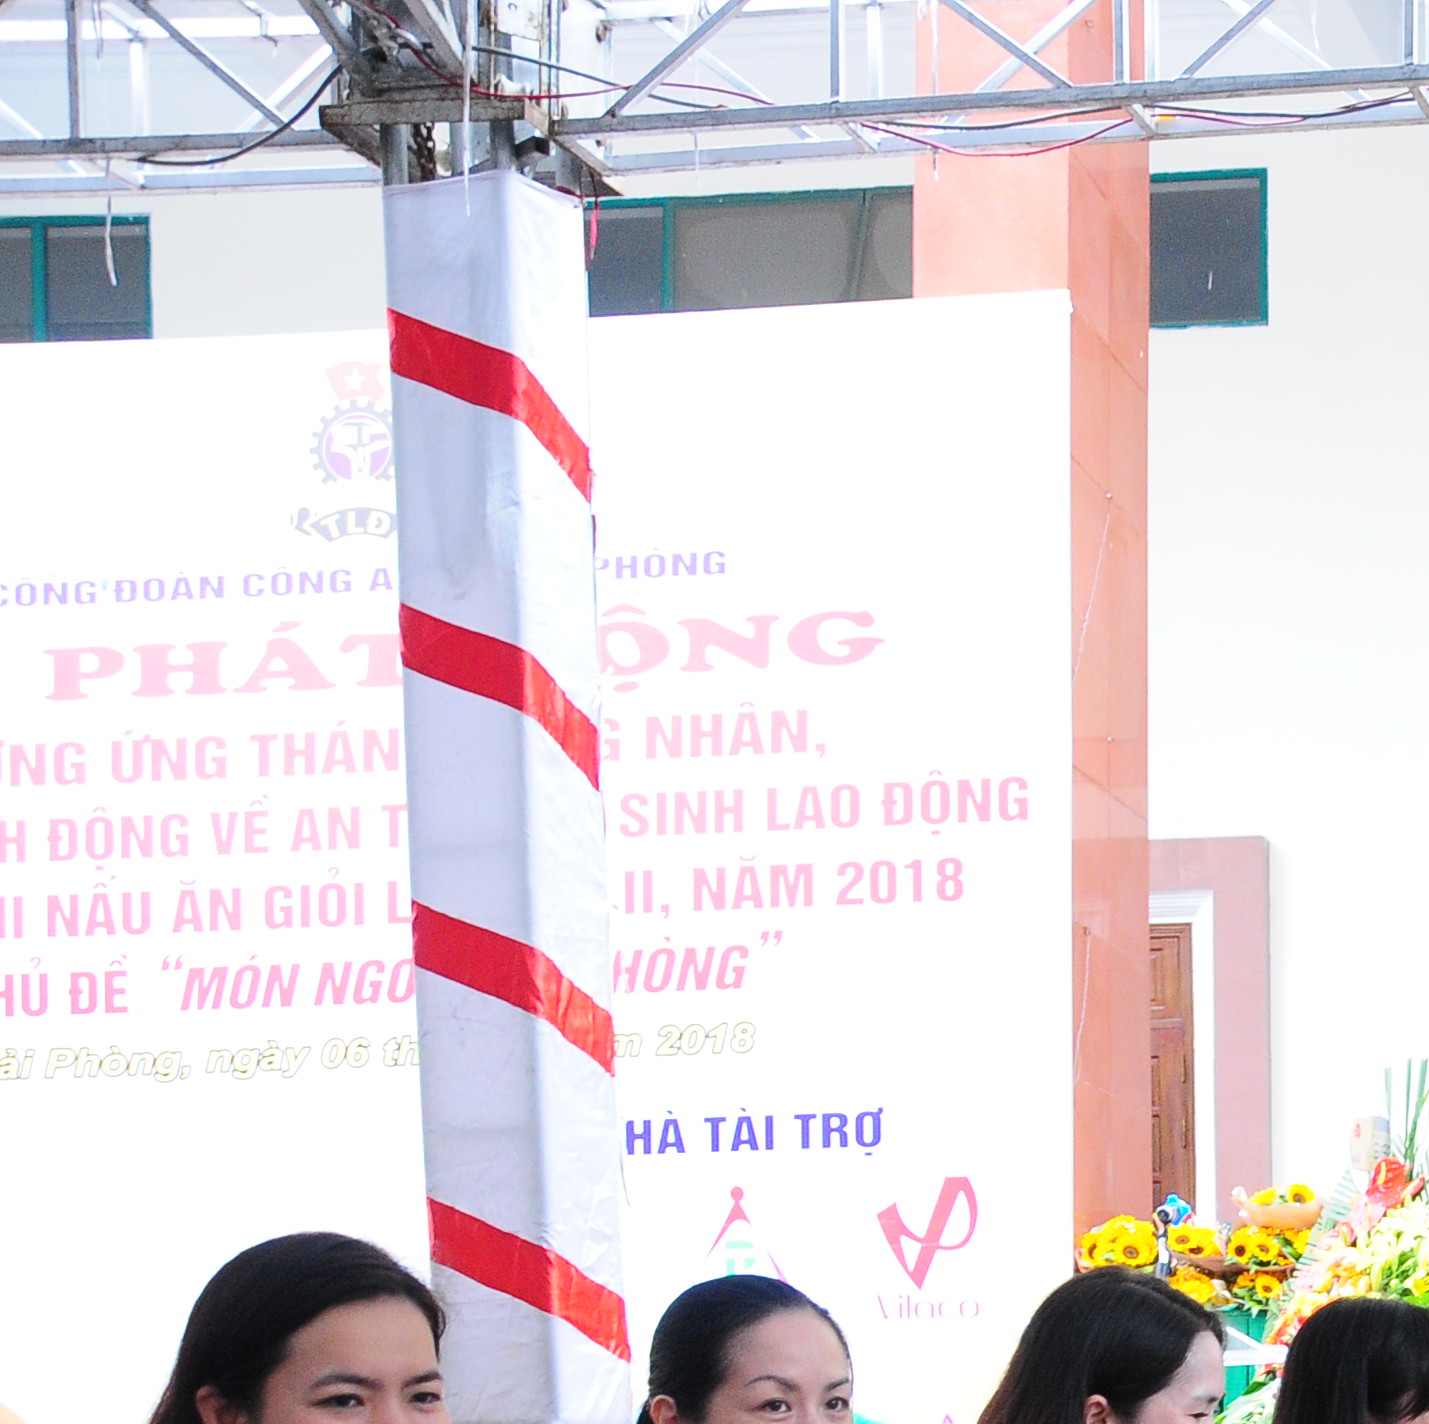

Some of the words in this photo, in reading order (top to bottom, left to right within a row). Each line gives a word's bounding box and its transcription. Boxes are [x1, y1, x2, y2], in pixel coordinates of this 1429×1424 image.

[113, 571, 225, 603] ĐOÀN
[243, 566, 353, 598] CÔNG
[43, 621, 402, 701] PHÁT
[0, 738, 87, 787] NG
[110, 730, 228, 784] ỨNG
[645, 702, 828, 760] NHÂN,
[48, 806, 190, 870] ĐỘNG
[210, 794, 270, 855] VỀ
[290, 805, 361, 852] AN
[619, 788, 744, 838] SINH
[766, 783, 861, 831] LAO
[882, 770, 1029, 836] ĐỘNG
[47, 876, 150, 937] NẤU
[172, 879, 242, 933] ĂN
[263, 867, 365, 929] GIỎI
[693, 856, 814, 912] NĂM
[836, 858, 965, 906] 2018
[69, 955, 128, 1015] ĐỀ
[44, 1045, 191, 1083] Phòng,
[206, 1040, 311, 1079] ngày
[320, 1037, 370, 1069] 06
[655, 1021, 756, 1057] 2018
[704, 1107, 774, 1153] TÀI
[794, 1107, 884, 1156] TRỢ
